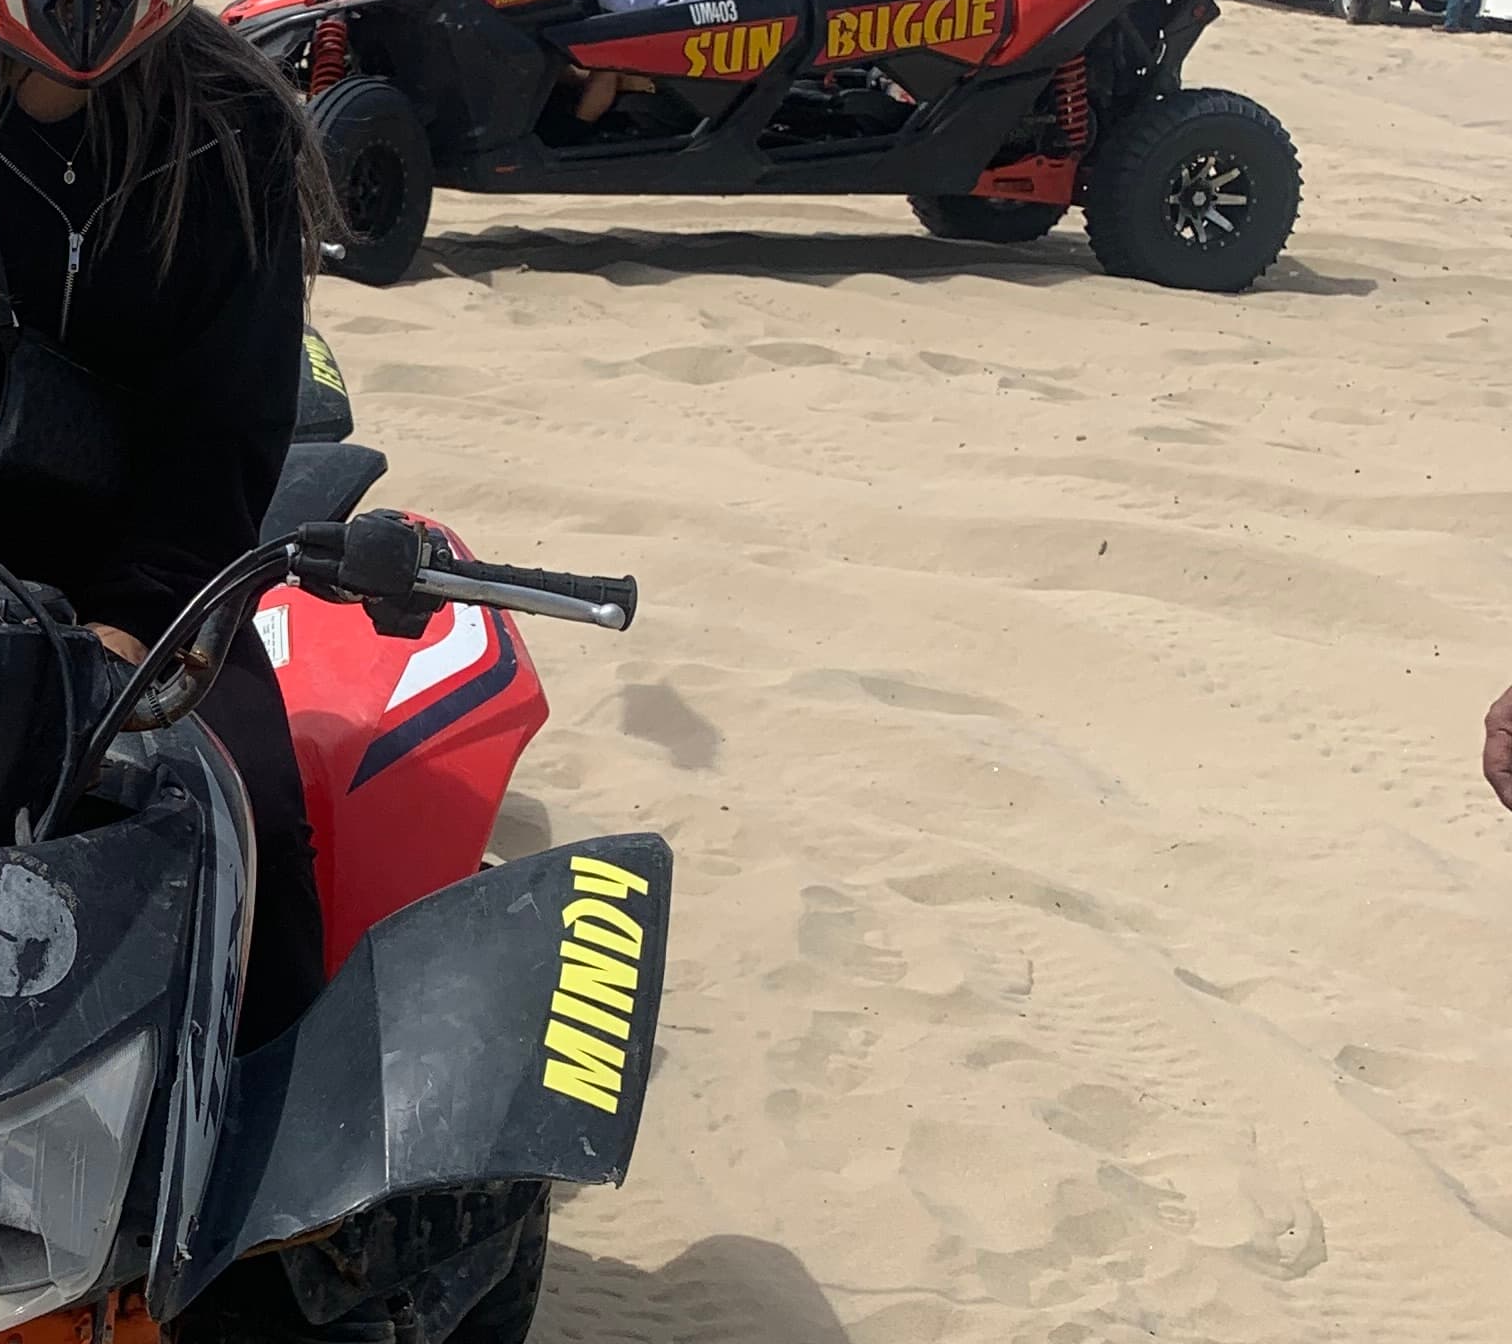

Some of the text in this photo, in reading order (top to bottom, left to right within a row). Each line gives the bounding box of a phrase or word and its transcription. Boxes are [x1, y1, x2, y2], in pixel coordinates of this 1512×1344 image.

[690, 0, 738, 26] UM403
[682, 19, 784, 79] SUN
[542, 855, 650, 1115] MINDY
